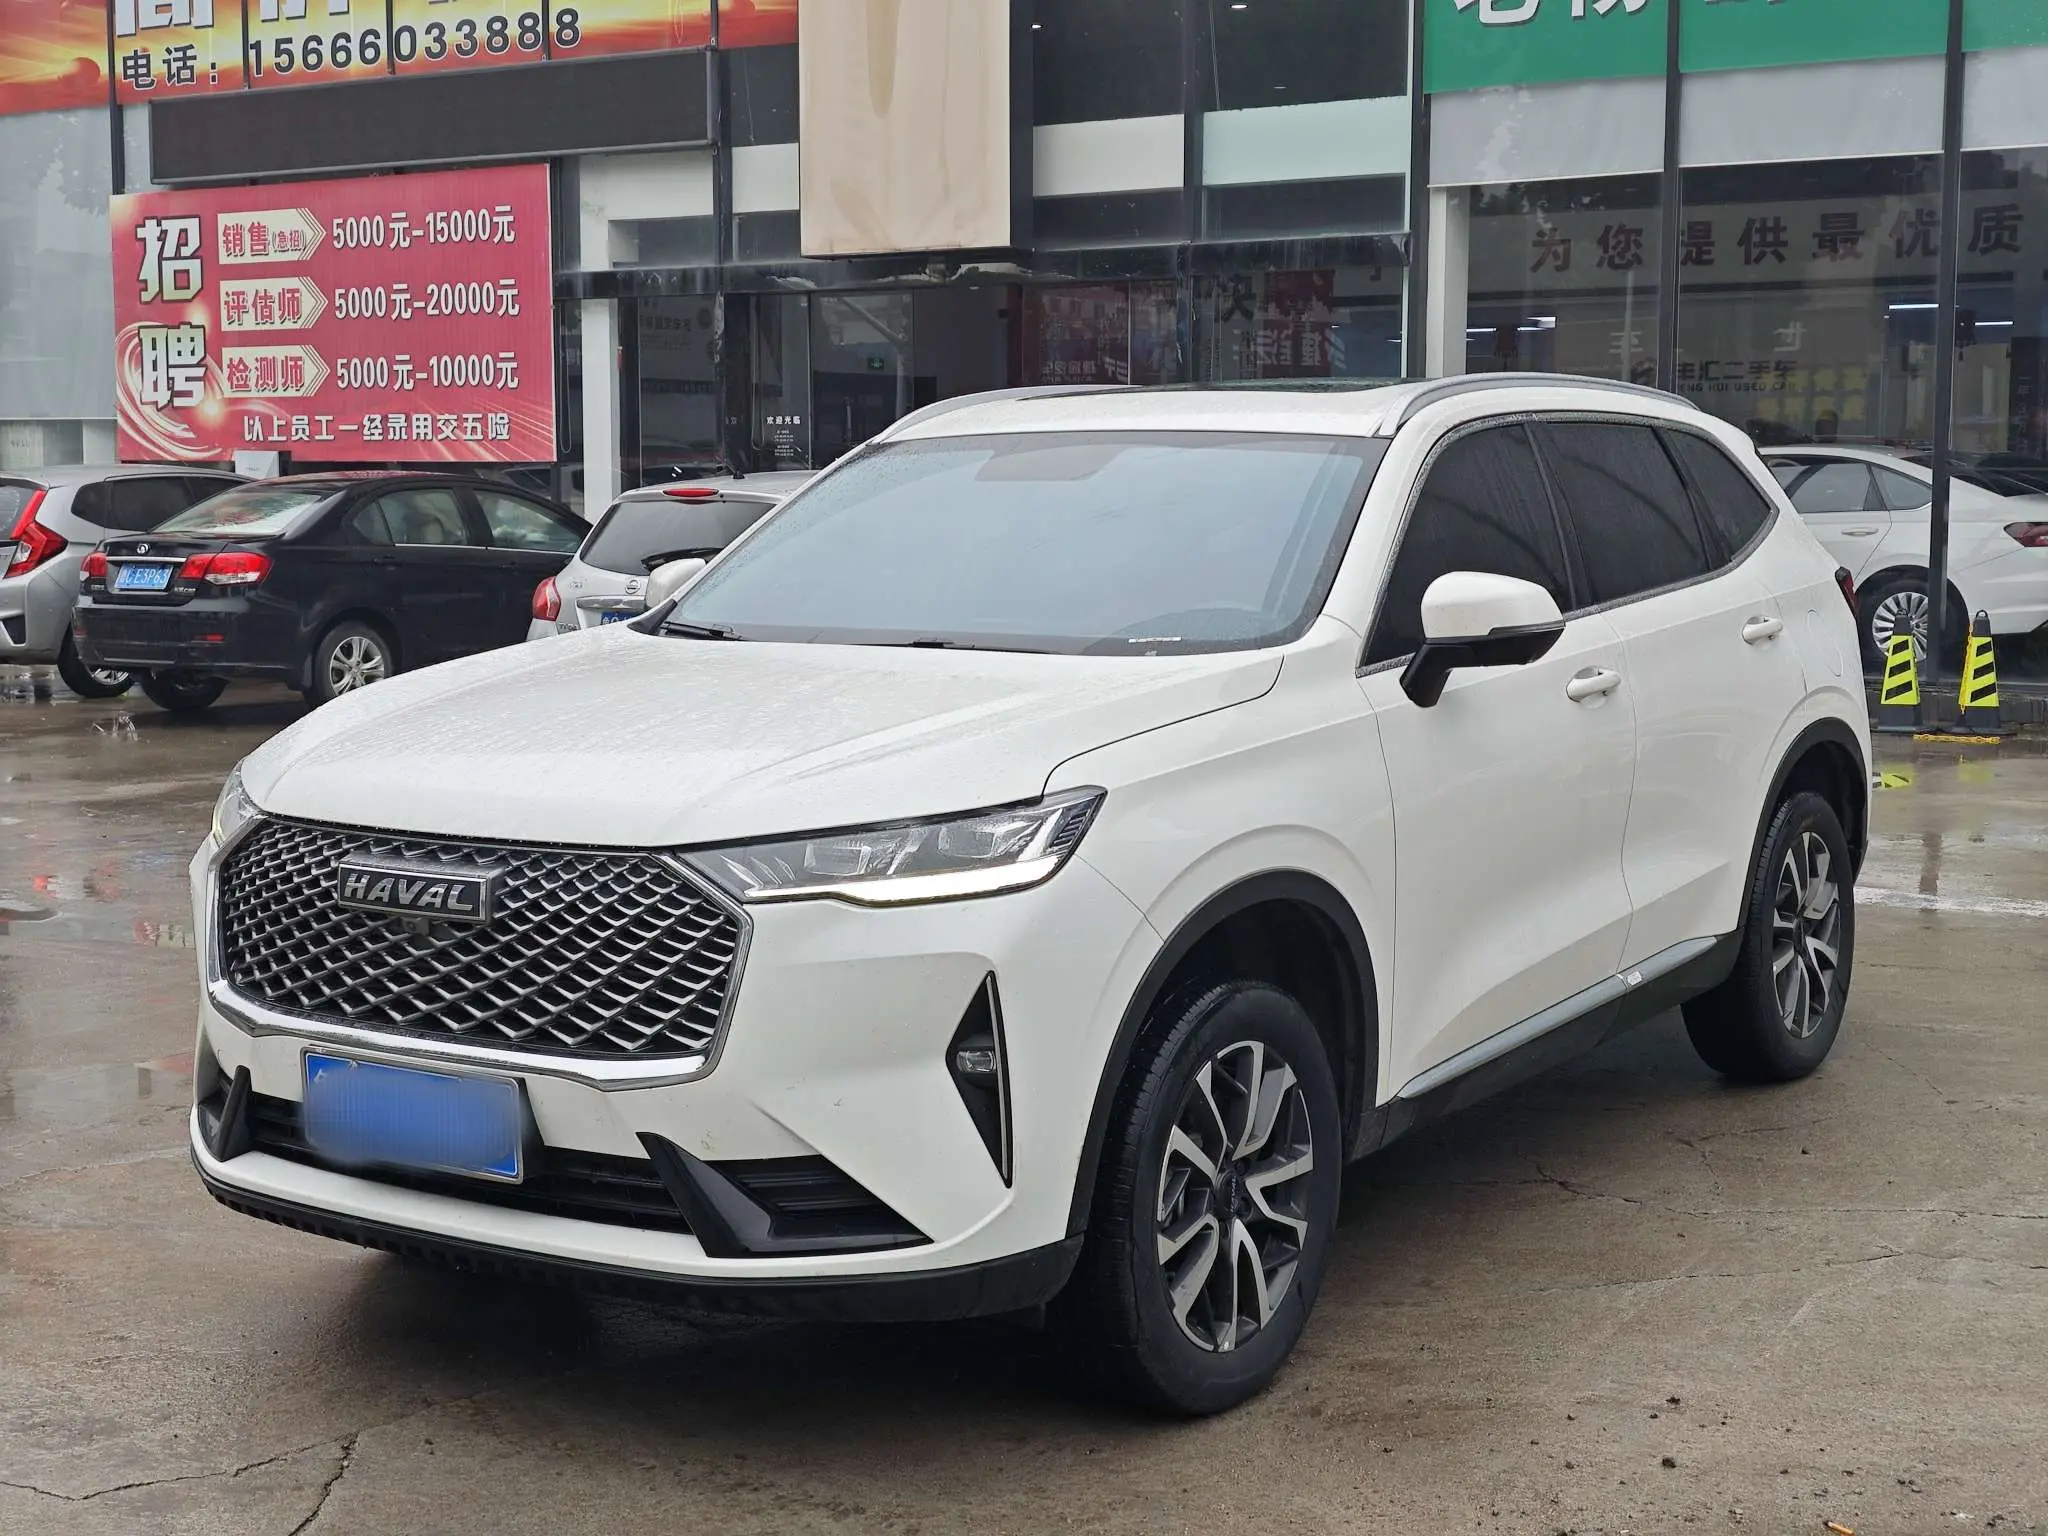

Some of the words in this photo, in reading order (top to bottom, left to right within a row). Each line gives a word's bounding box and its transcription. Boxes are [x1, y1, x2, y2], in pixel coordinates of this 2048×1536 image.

[247, 8, 583, 77] 15666033888
[332, 205, 516, 249] 5000元-15000元
[136, 215, 207, 412] 招聘
[223, 290, 303, 324] 评估师
[334, 279, 521, 321] 5000元-20000元
[227, 355, 306, 391] 检测师
[336, 352, 520, 392] 5000元-10000元
[344, 873, 472, 911] HAVAL
